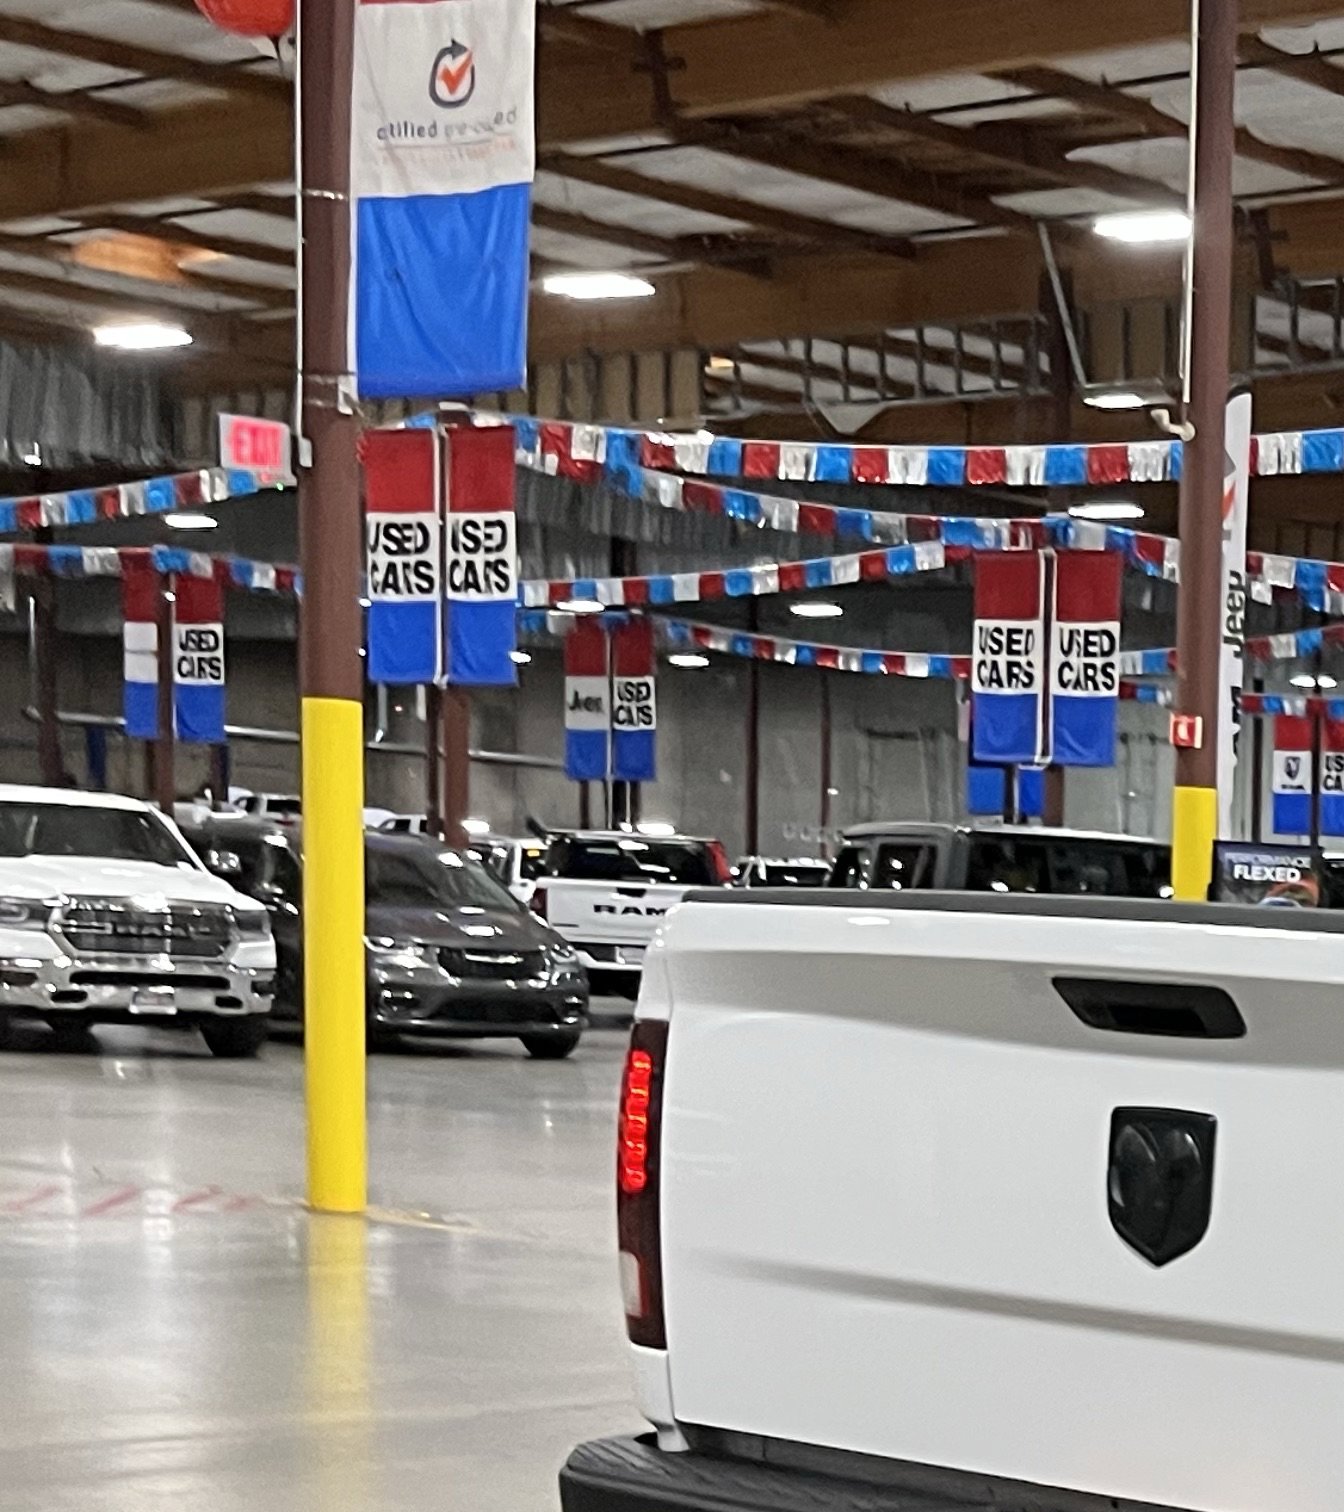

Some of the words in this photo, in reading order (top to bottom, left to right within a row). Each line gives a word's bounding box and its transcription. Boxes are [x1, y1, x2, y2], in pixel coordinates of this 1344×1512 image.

[979, 626, 1035, 656] USED
[1060, 628, 1116, 658] USED
[977, 659, 1034, 689] CARS
[1058, 661, 1115, 691] CARS
[1233, 864, 1301, 882] FLEXED
